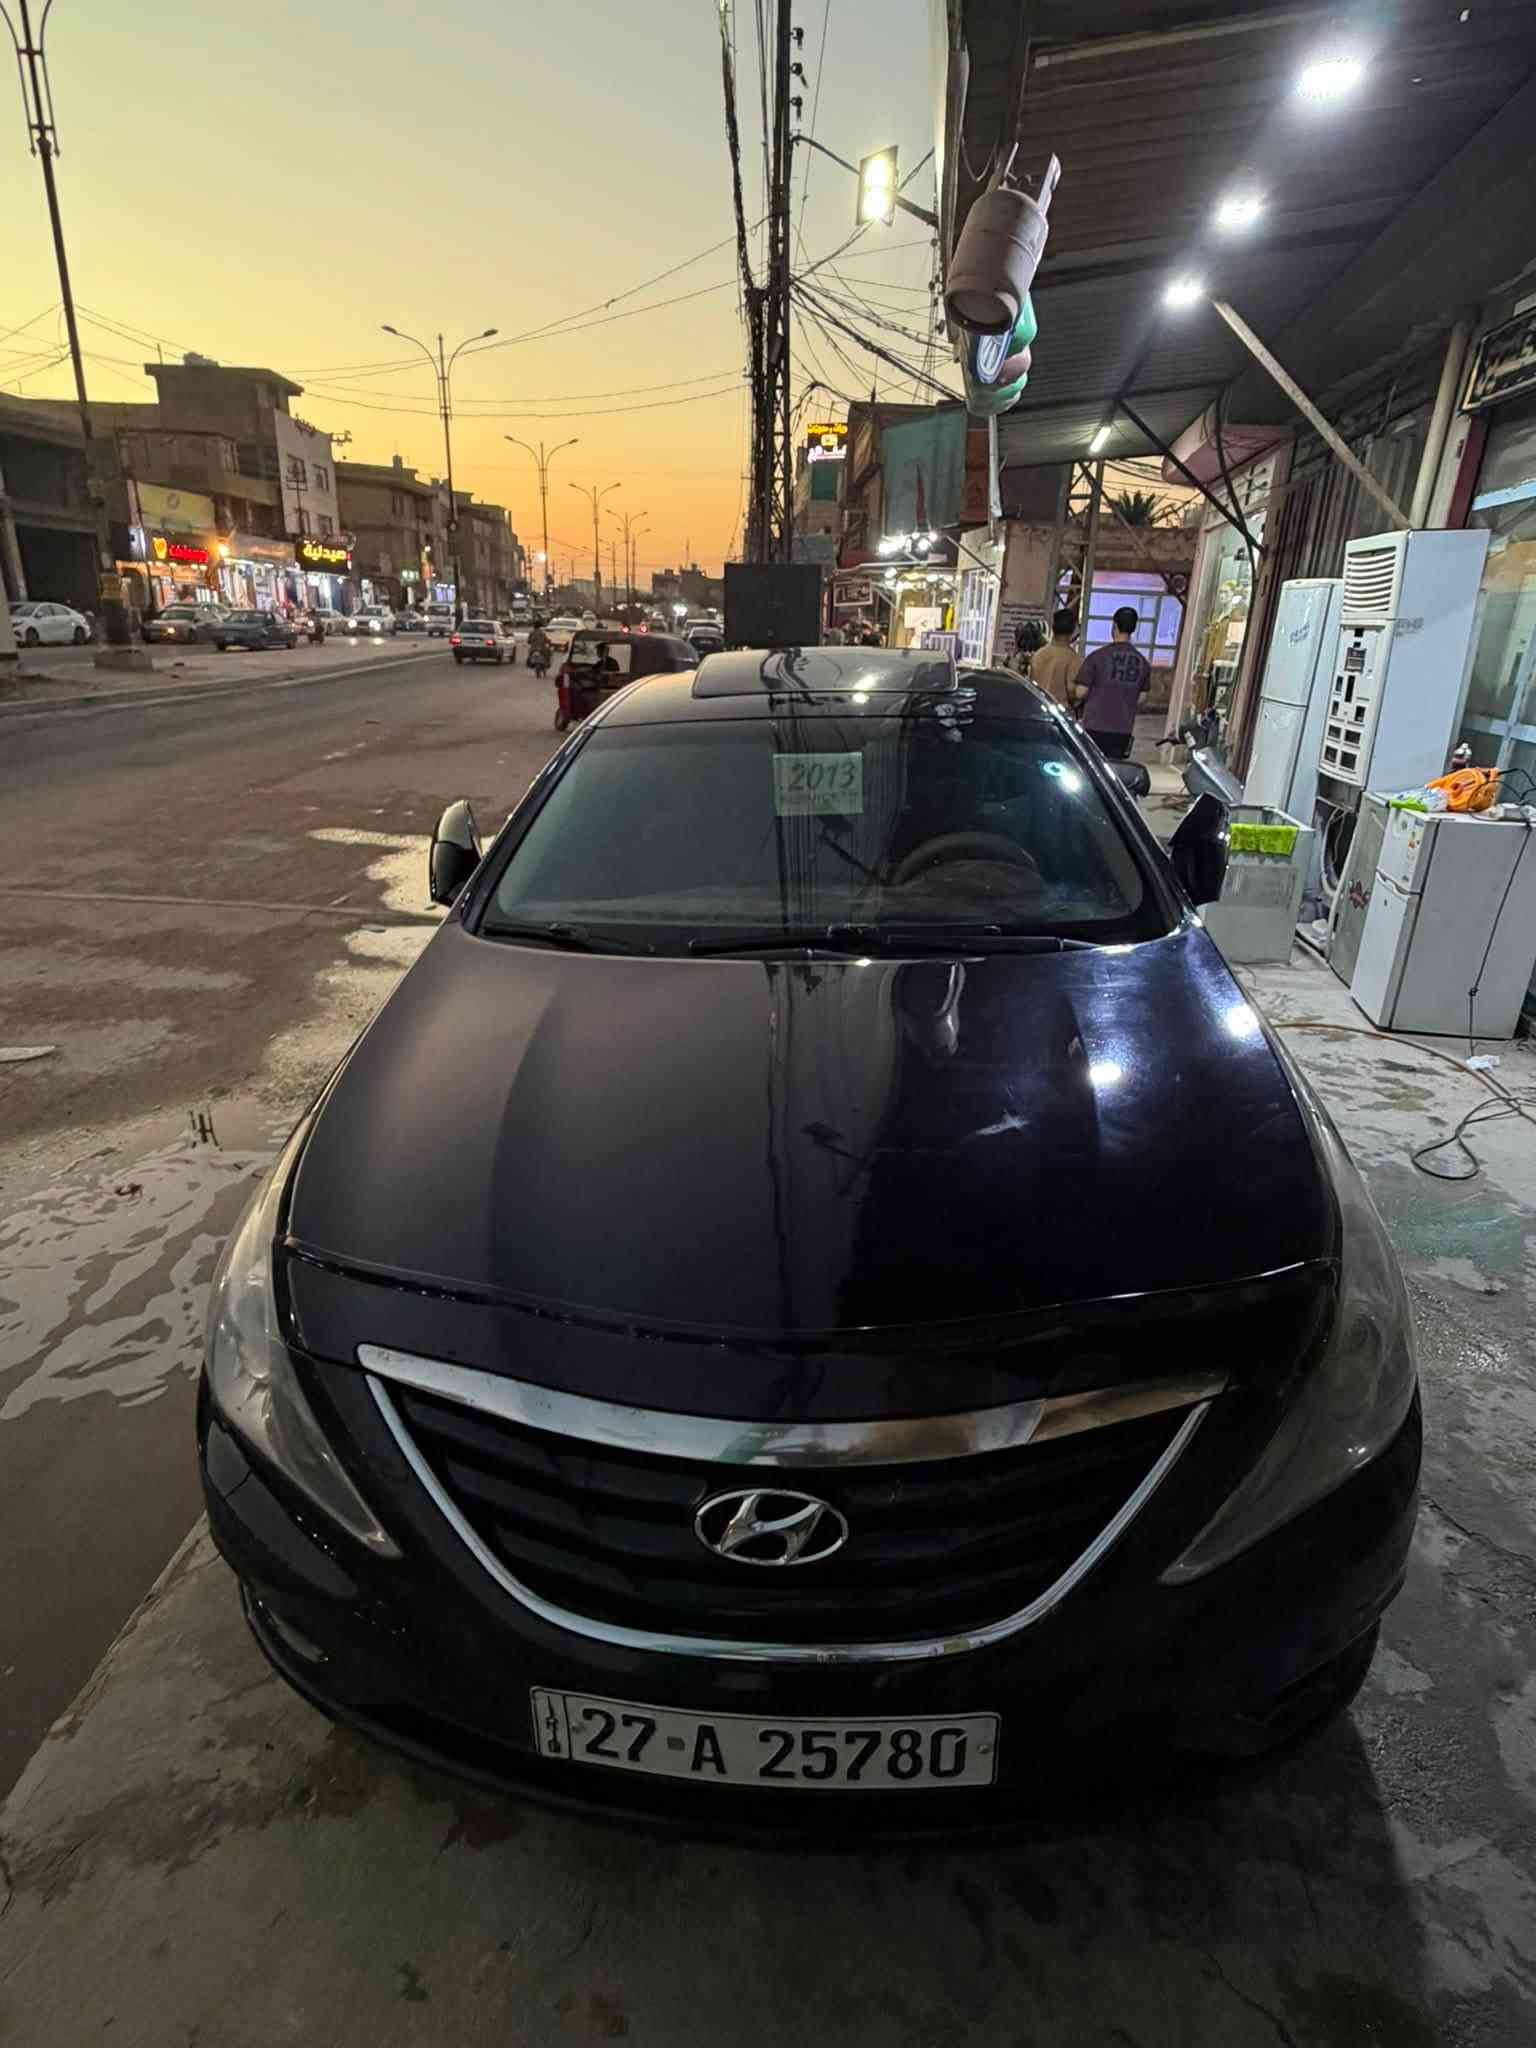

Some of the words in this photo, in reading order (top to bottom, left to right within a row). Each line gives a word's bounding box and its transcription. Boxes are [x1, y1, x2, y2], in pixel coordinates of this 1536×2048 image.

[789, 759, 857, 792] 2013
[581, 1707, 657, 1763] 27
[690, 1725, 727, 1775] A
[757, 1726, 968, 1782] 25780
